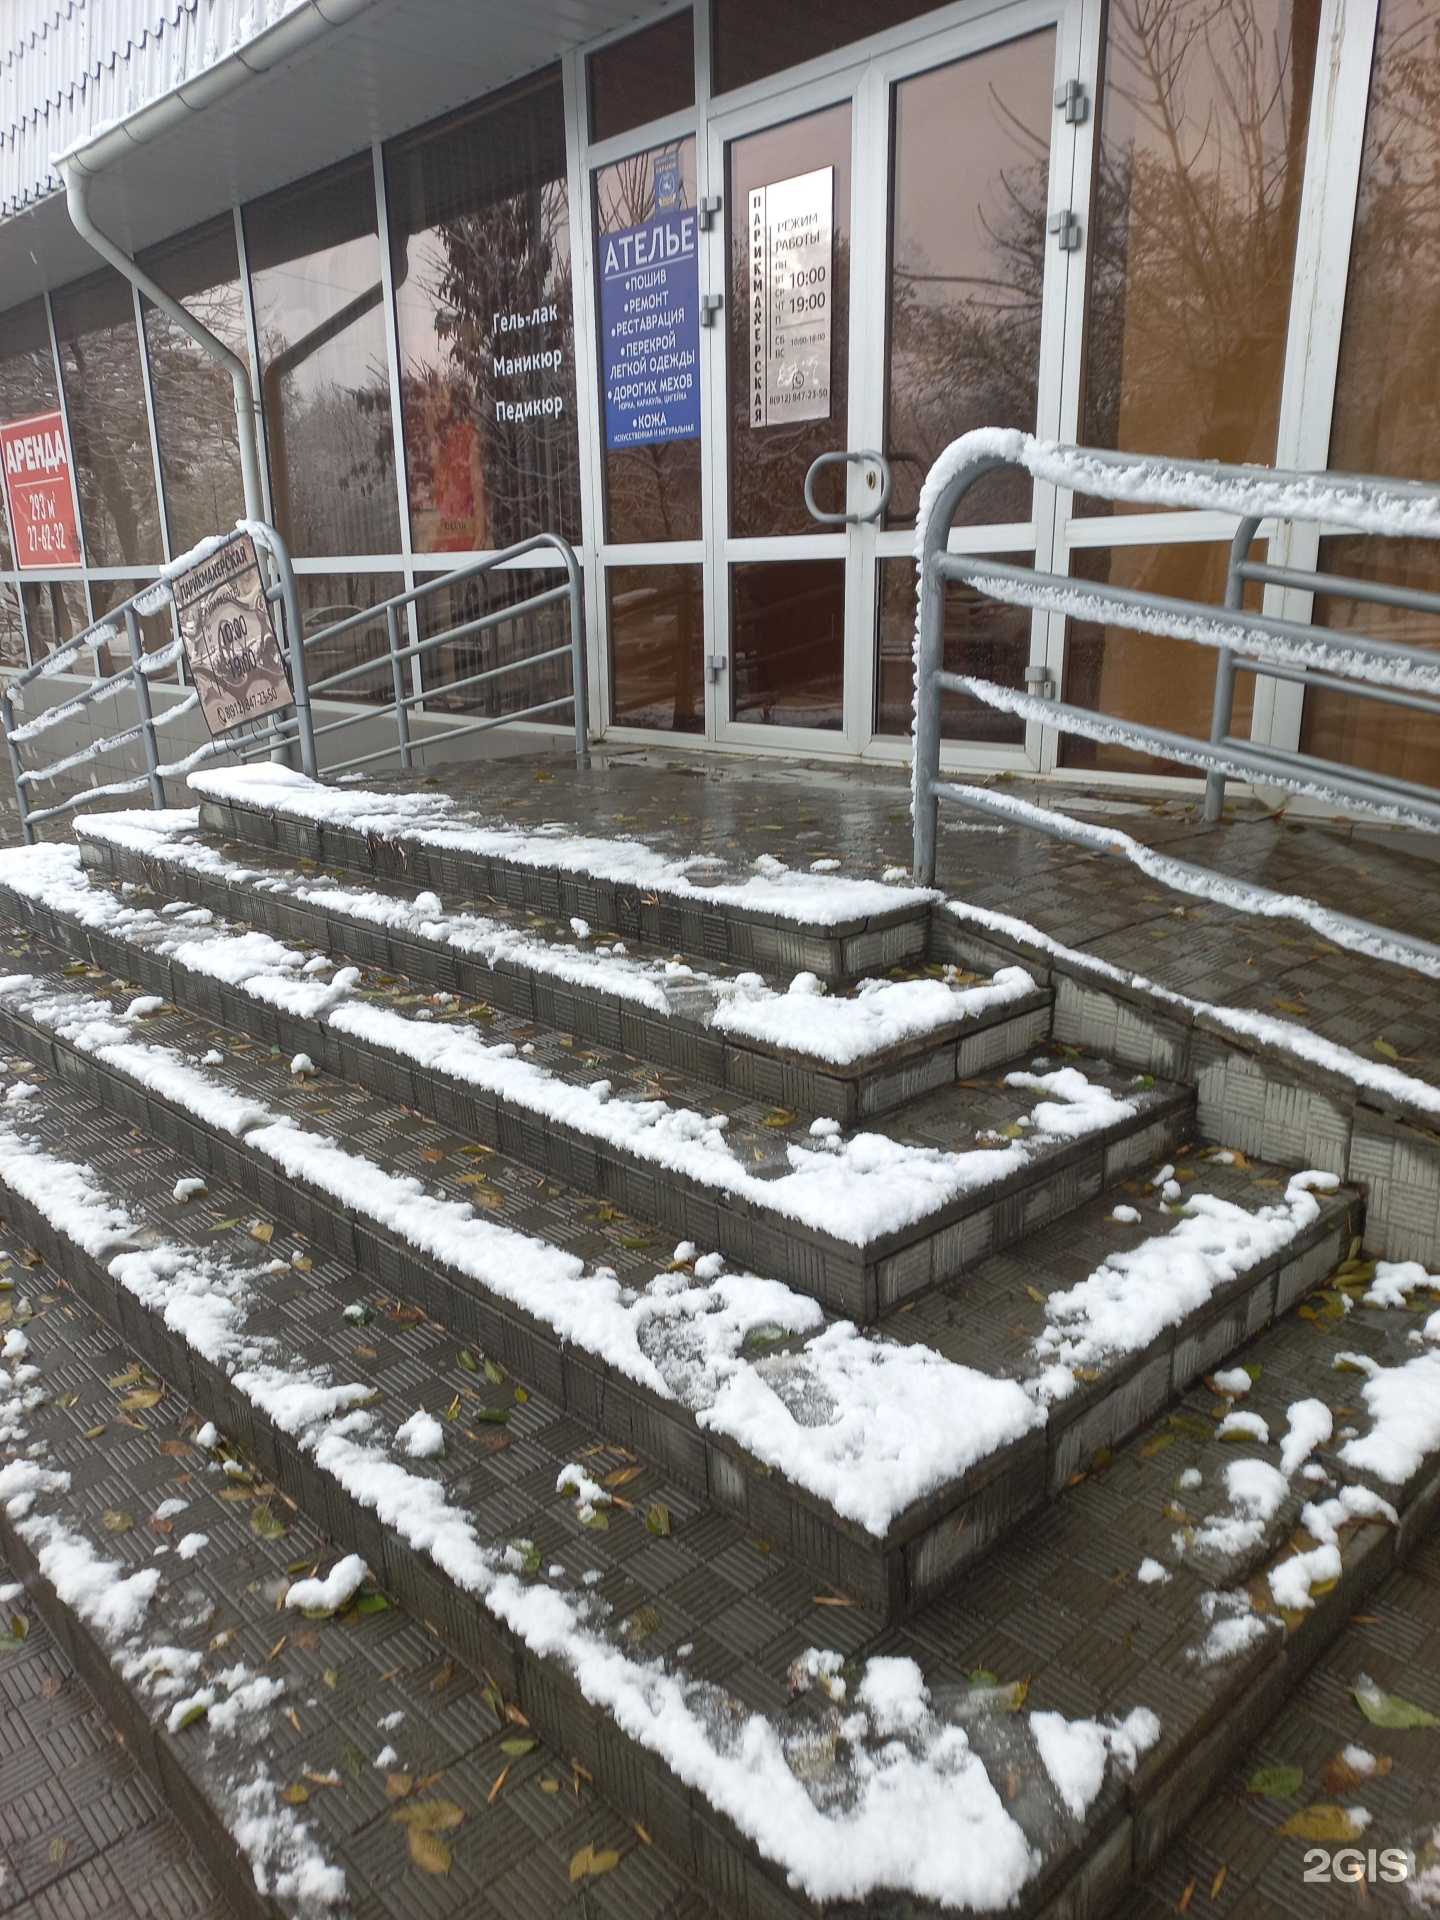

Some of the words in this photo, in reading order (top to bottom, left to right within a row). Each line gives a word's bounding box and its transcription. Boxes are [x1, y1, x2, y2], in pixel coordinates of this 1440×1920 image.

[777, 212, 819, 233] РЕЖИМ
[604, 216, 695, 274] АТЕЛЬЕ
[775, 230, 820, 254] РАБОТЫ
[630, 268, 667, 292] ПОШИВ
[790, 266, 826, 288] 10:00
[629, 290, 669, 314] РЕМОНТ
[753, 195, 763, 422] ПАРИКМАХЕРСКАЯ
[790, 292, 826, 314] 19:00
[493, 303, 558, 334] Гель-лак
[616, 307, 685, 337] РЕСТАВРАЦИЯ
[626, 330, 676, 358] ПЕРЕКРОЙ
[493, 349, 562, 378] Маникюр
[610, 356, 647, 381] ЛЕГКОЙ
[649, 348, 695, 374] ОДЕЖДЫ
[613, 379, 657, 405] ДОРОГИХ
[659, 373, 693, 393] МЕХОВ
[495, 396, 563, 424] Педикюр
[638, 412, 667, 429] КОЖА
[5, 430, 67, 475] АРЕНДА
[29, 493, 46, 521] 293
[27, 521, 66, 551] 27-62-32
[179, 545, 248, 602] ПАРИКМАХЕРСКАЯ
